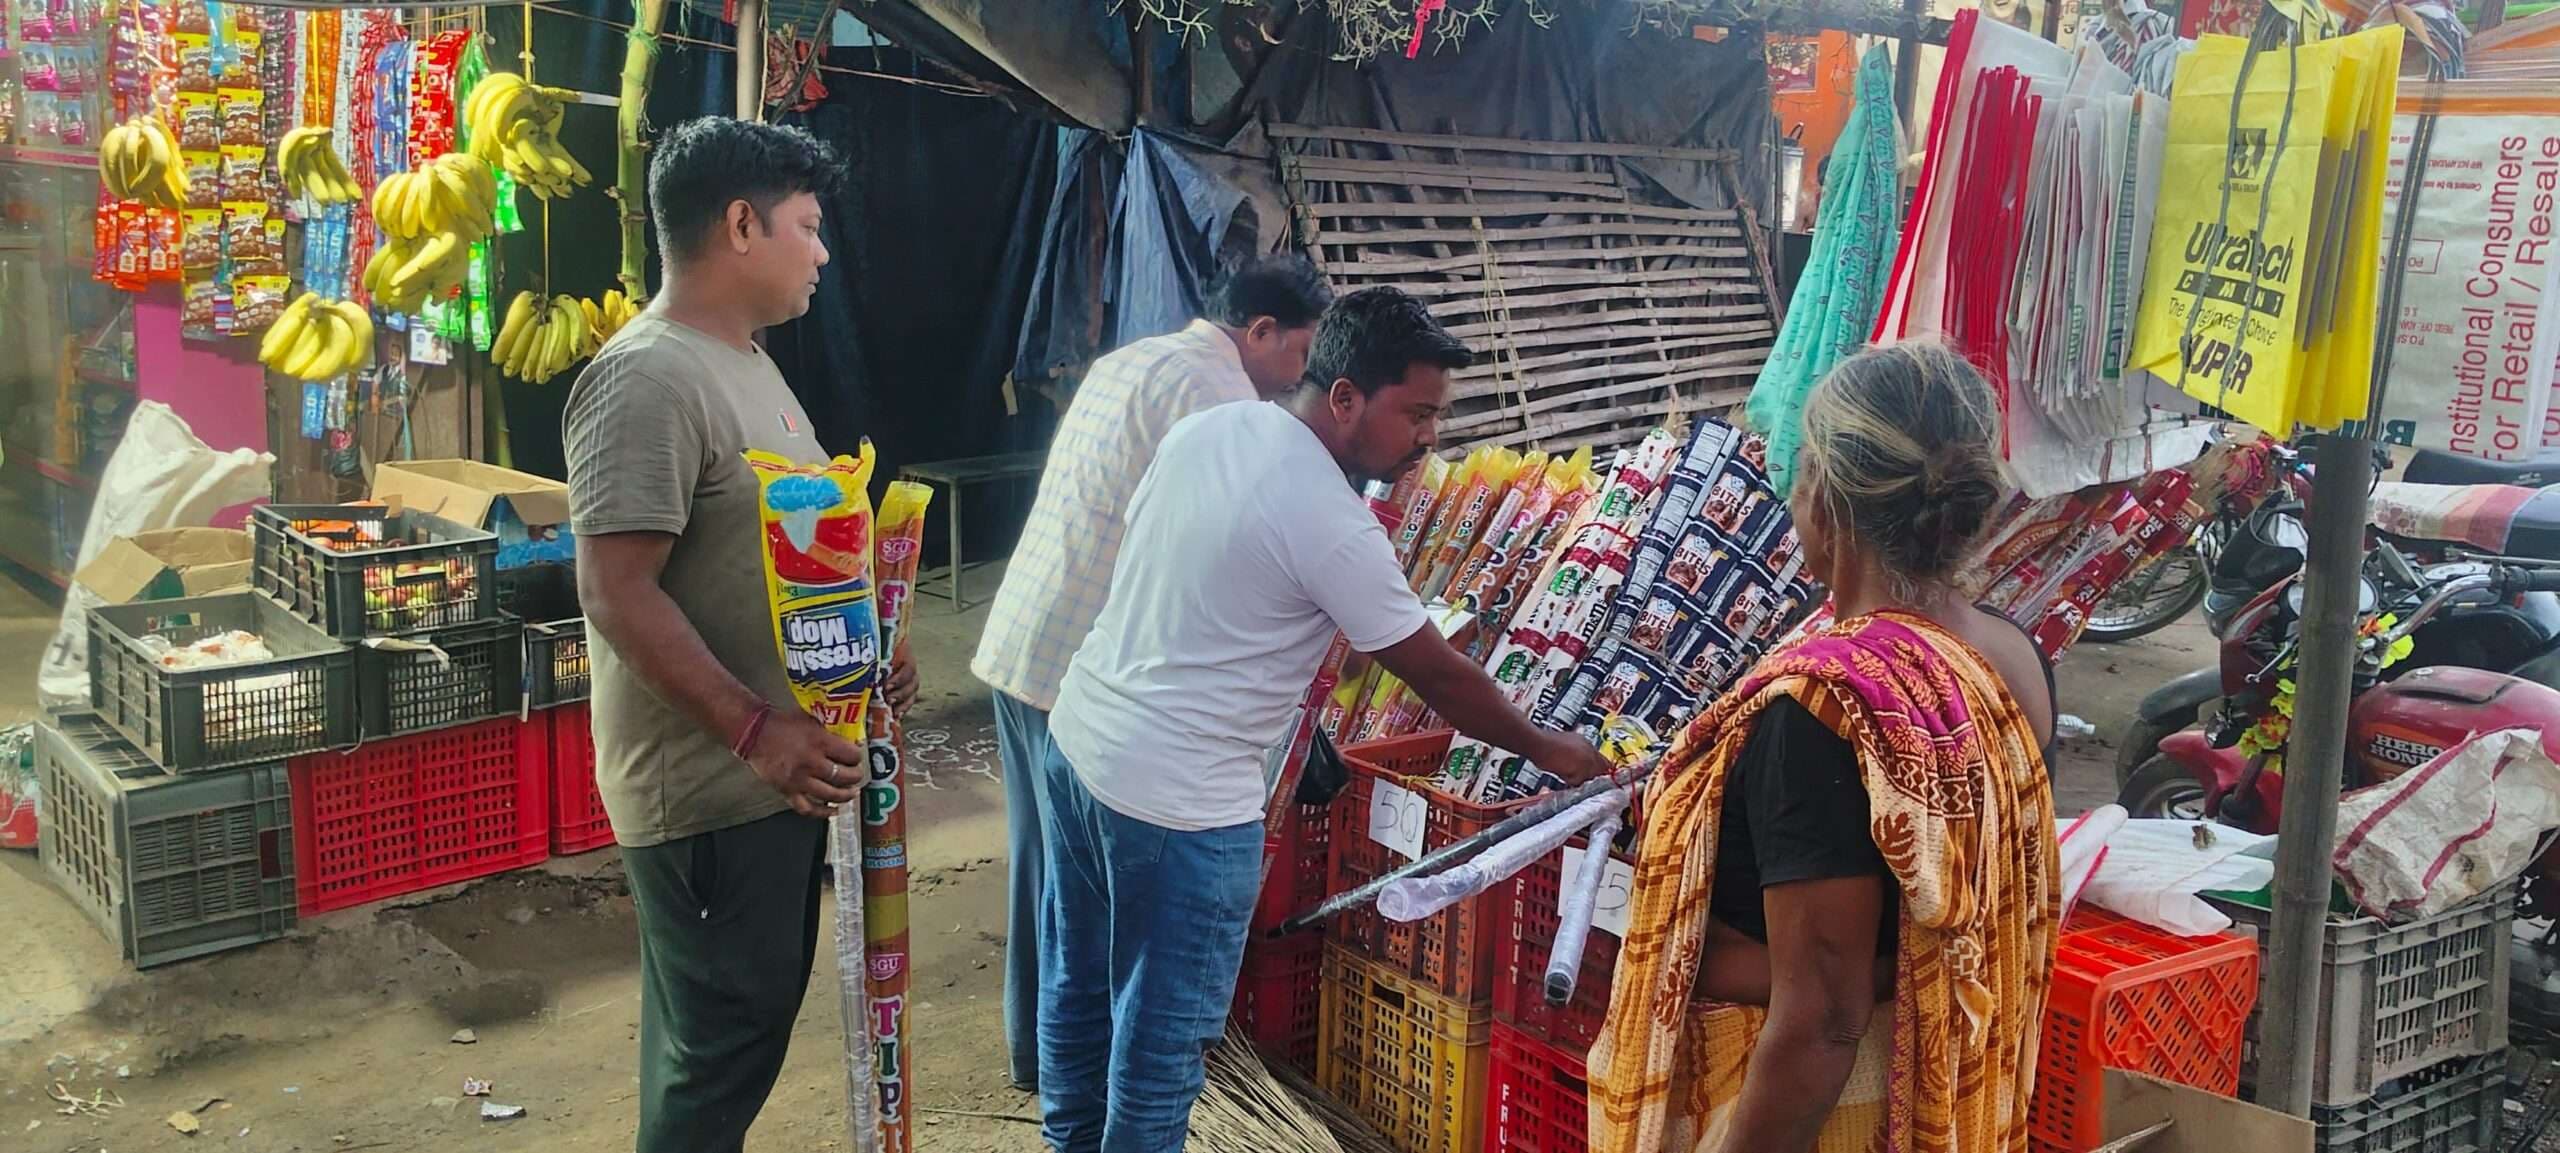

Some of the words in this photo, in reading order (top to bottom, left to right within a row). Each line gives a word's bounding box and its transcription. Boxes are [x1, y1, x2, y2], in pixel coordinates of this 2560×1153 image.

[2466, 136, 2527, 298] Consumers
[2514, 136, 2560, 265] Resale
[2182, 334, 2253, 394] UPR
[2491, 303, 2538, 403] Retail
[2447, 307, 2494, 453] nstitutional
[2483, 415, 2521, 461] or
[1711, 485, 1752, 516] BITES
[1674, 546, 1712, 576] BITES
[790, 614, 848, 647] Mop
[784, 636, 876, 676] Pressin
[2369, 743, 2432, 766] HON
[2376, 733, 2444, 758] HERO
[1510, 878, 1525, 985] FRUIT
[870, 956, 899, 971] SGU
